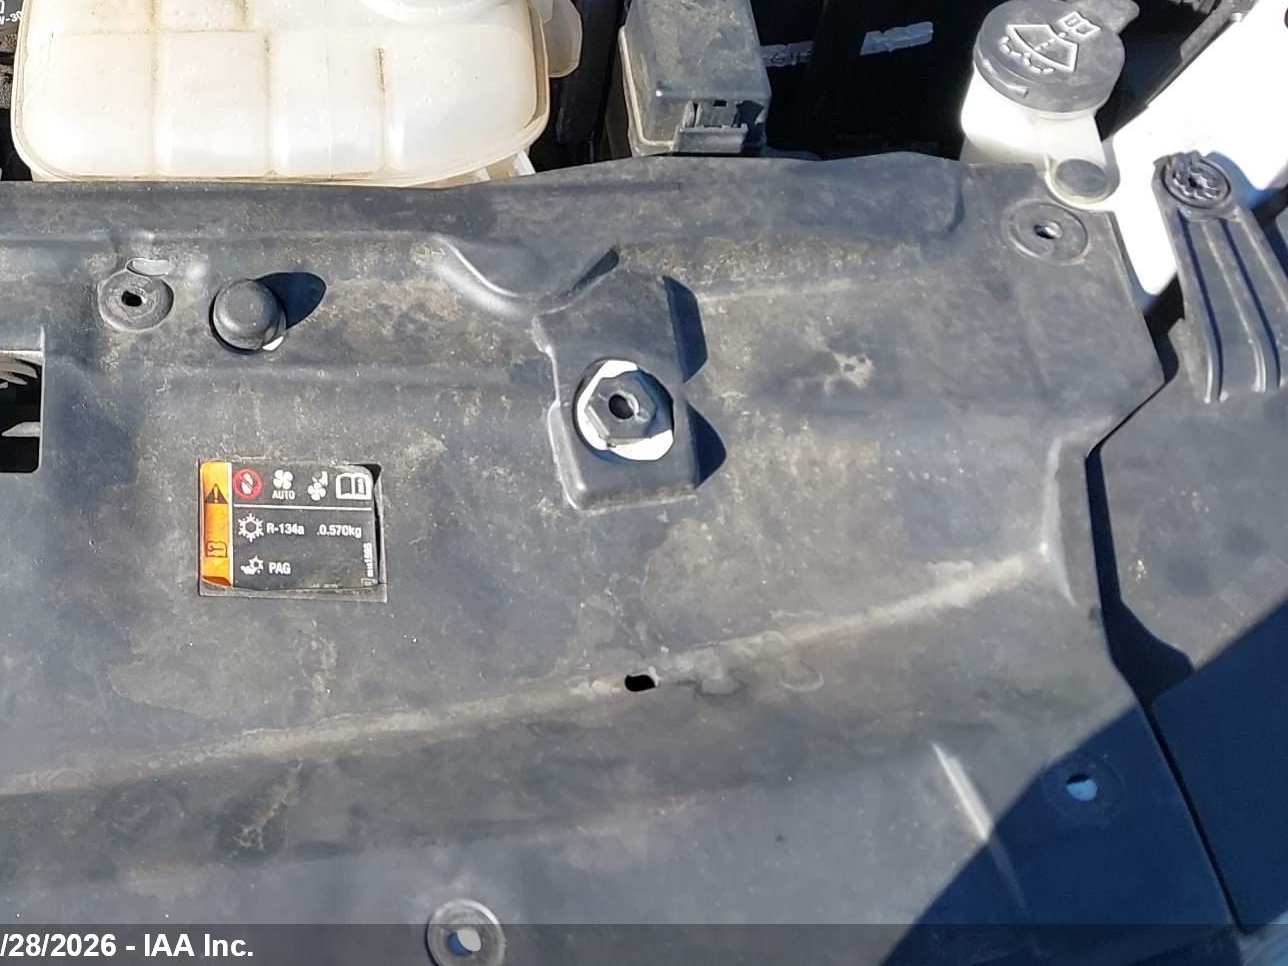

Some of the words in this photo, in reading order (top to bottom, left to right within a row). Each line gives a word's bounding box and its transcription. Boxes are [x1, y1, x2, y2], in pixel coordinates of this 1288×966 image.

[272, 490, 296, 500] AUTO
[266, 522, 305, 535] R-134a
[269, 562, 292, 575] PAG
